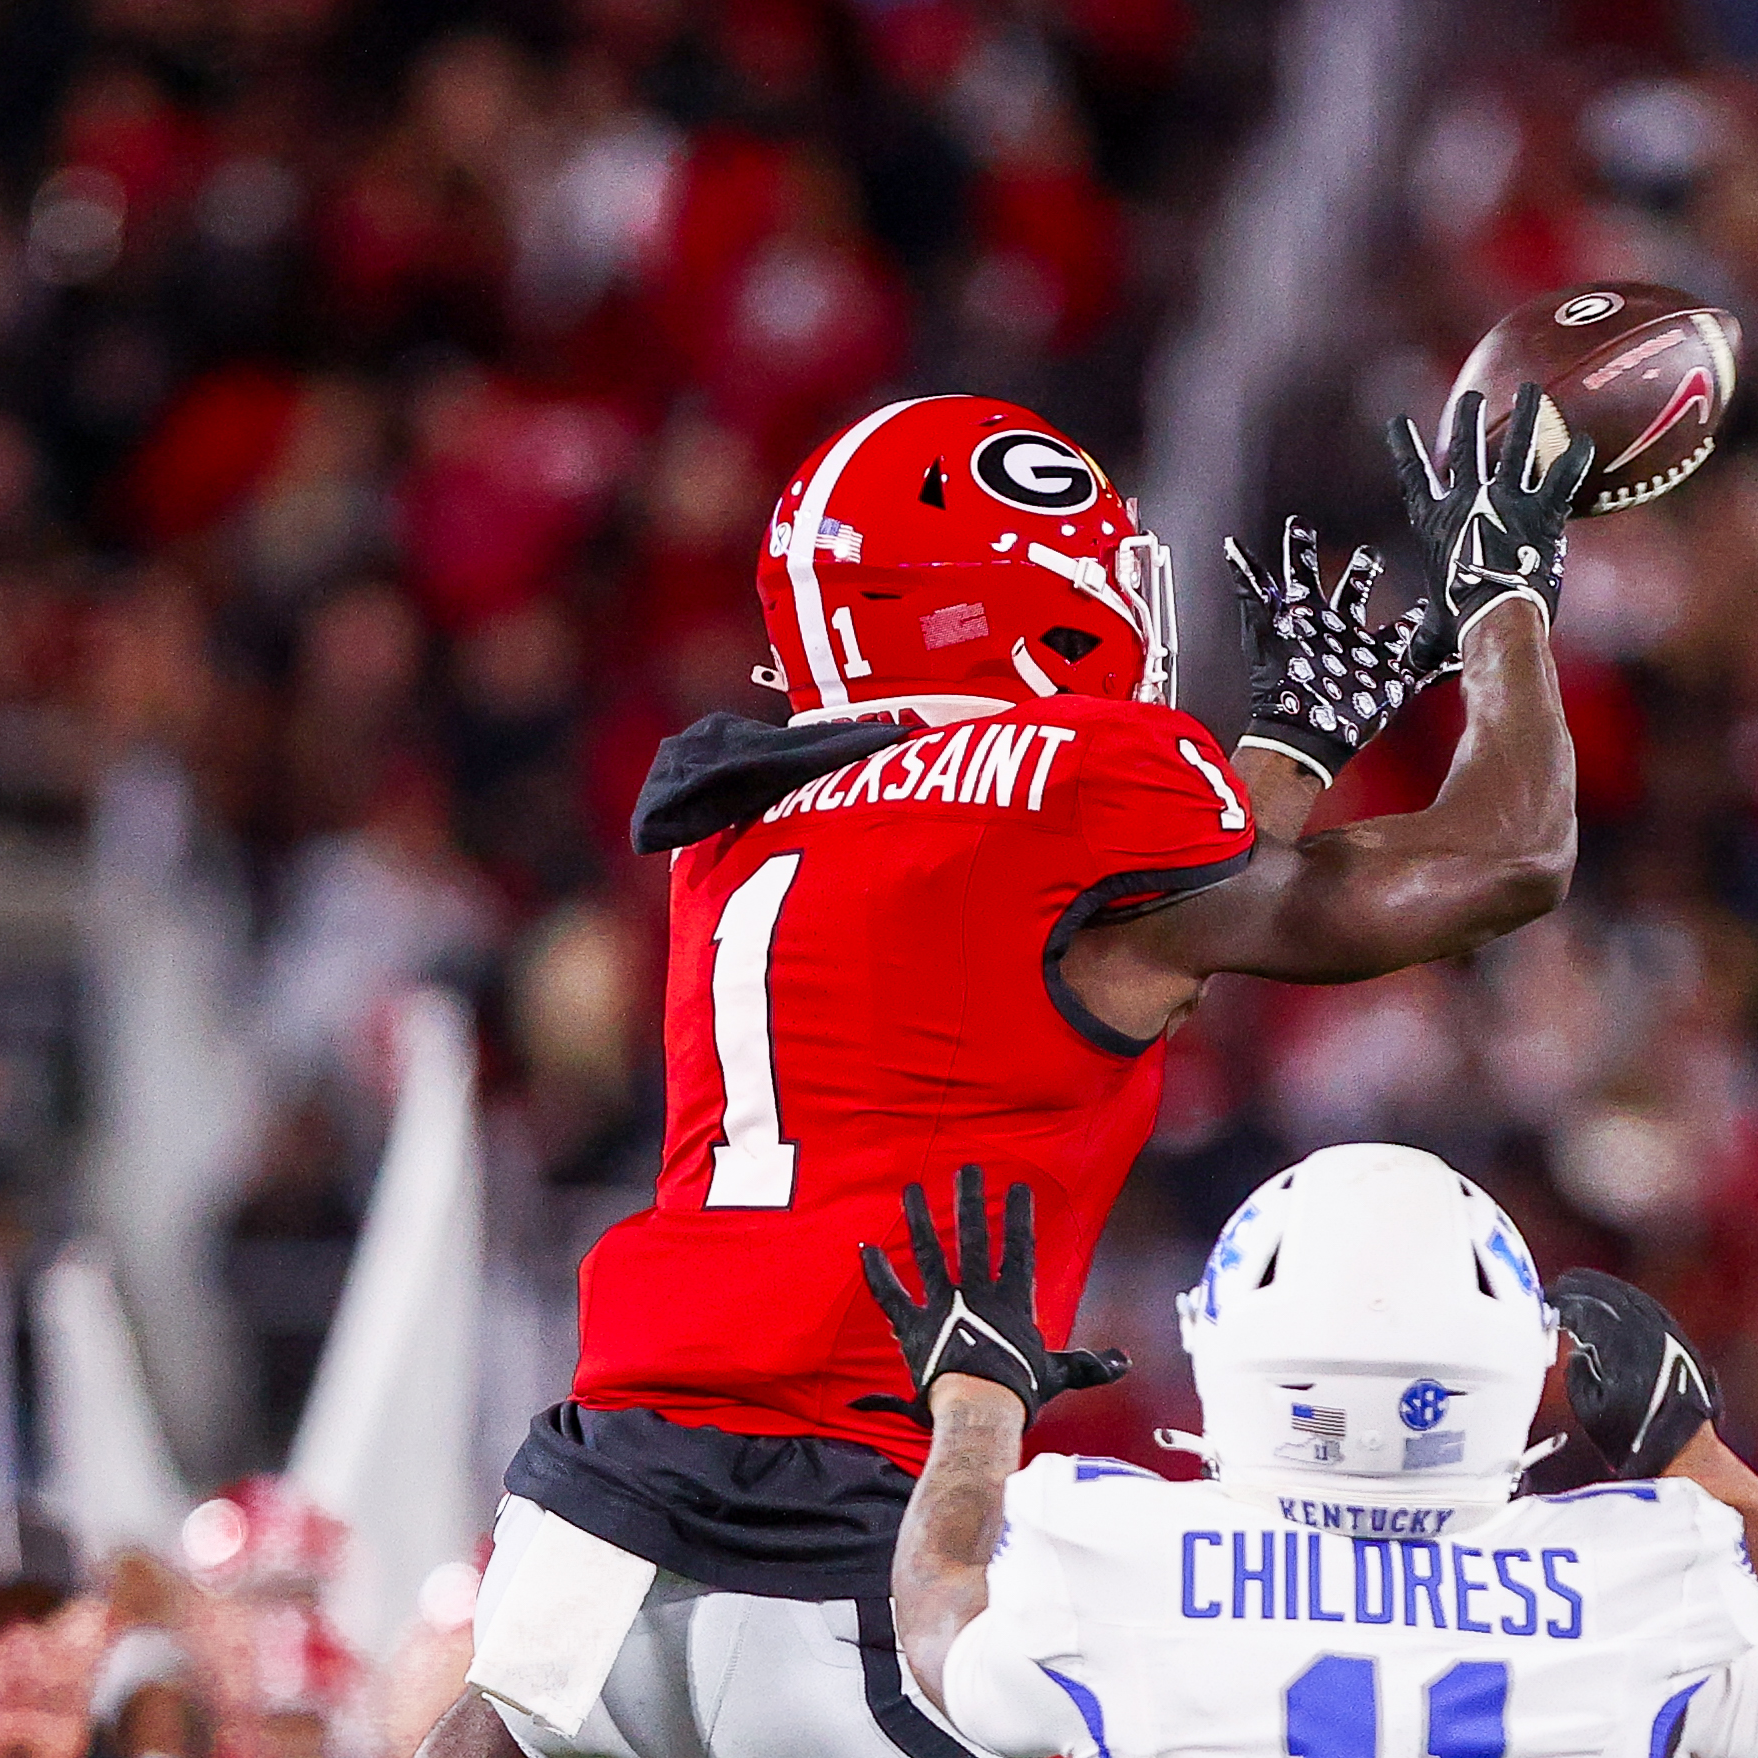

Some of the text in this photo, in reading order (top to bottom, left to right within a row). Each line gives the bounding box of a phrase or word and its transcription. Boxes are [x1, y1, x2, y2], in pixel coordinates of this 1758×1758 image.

[973, 432, 1096, 512] G
[831, 606, 873, 679] 1
[1179, 737, 1246, 830] 1
[704, 849, 804, 1211] 1
[1278, 1496, 1456, 1535] KENTUCKY
[1180, 1530, 1583, 1640] CHILDRESS
